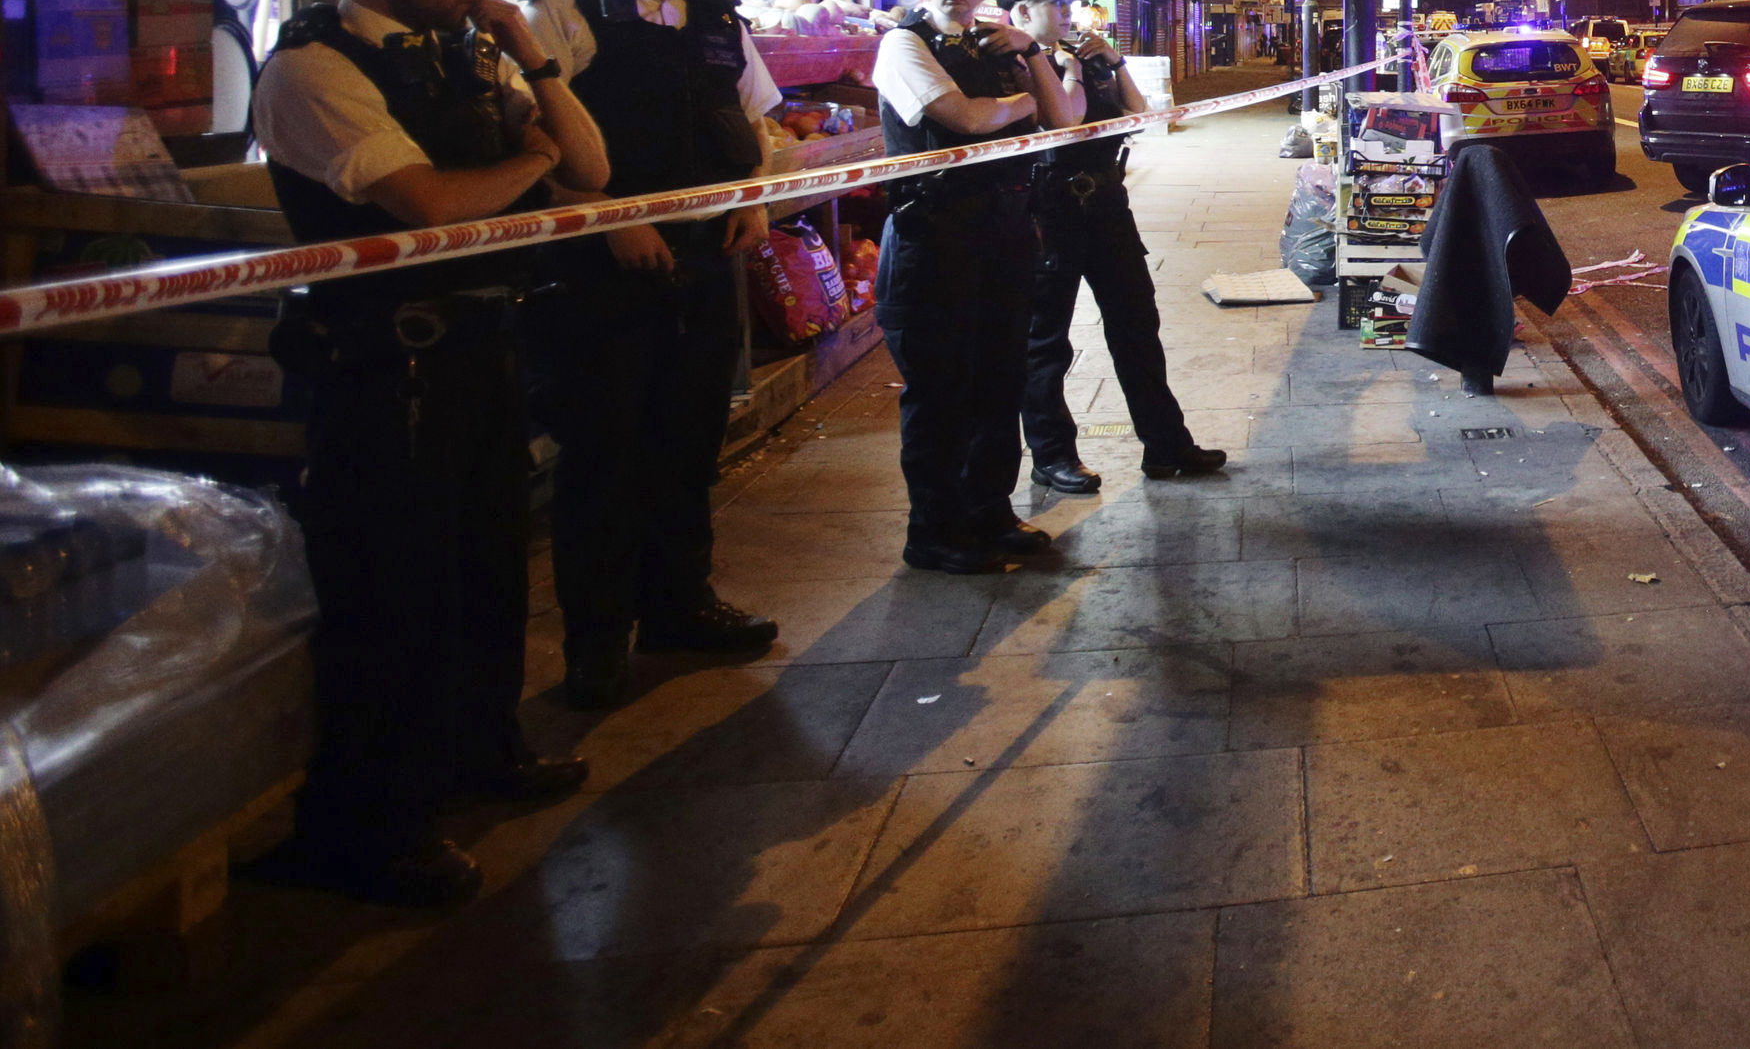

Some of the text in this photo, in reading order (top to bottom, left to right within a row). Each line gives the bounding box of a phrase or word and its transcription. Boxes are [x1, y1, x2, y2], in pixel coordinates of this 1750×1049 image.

[1553, 63, 1579, 73] BWT
[1686, 79, 1730, 90] BX66 CZE
[1506, 100, 1533, 110] BX64
[1491, 112, 1575, 126] POLICE
